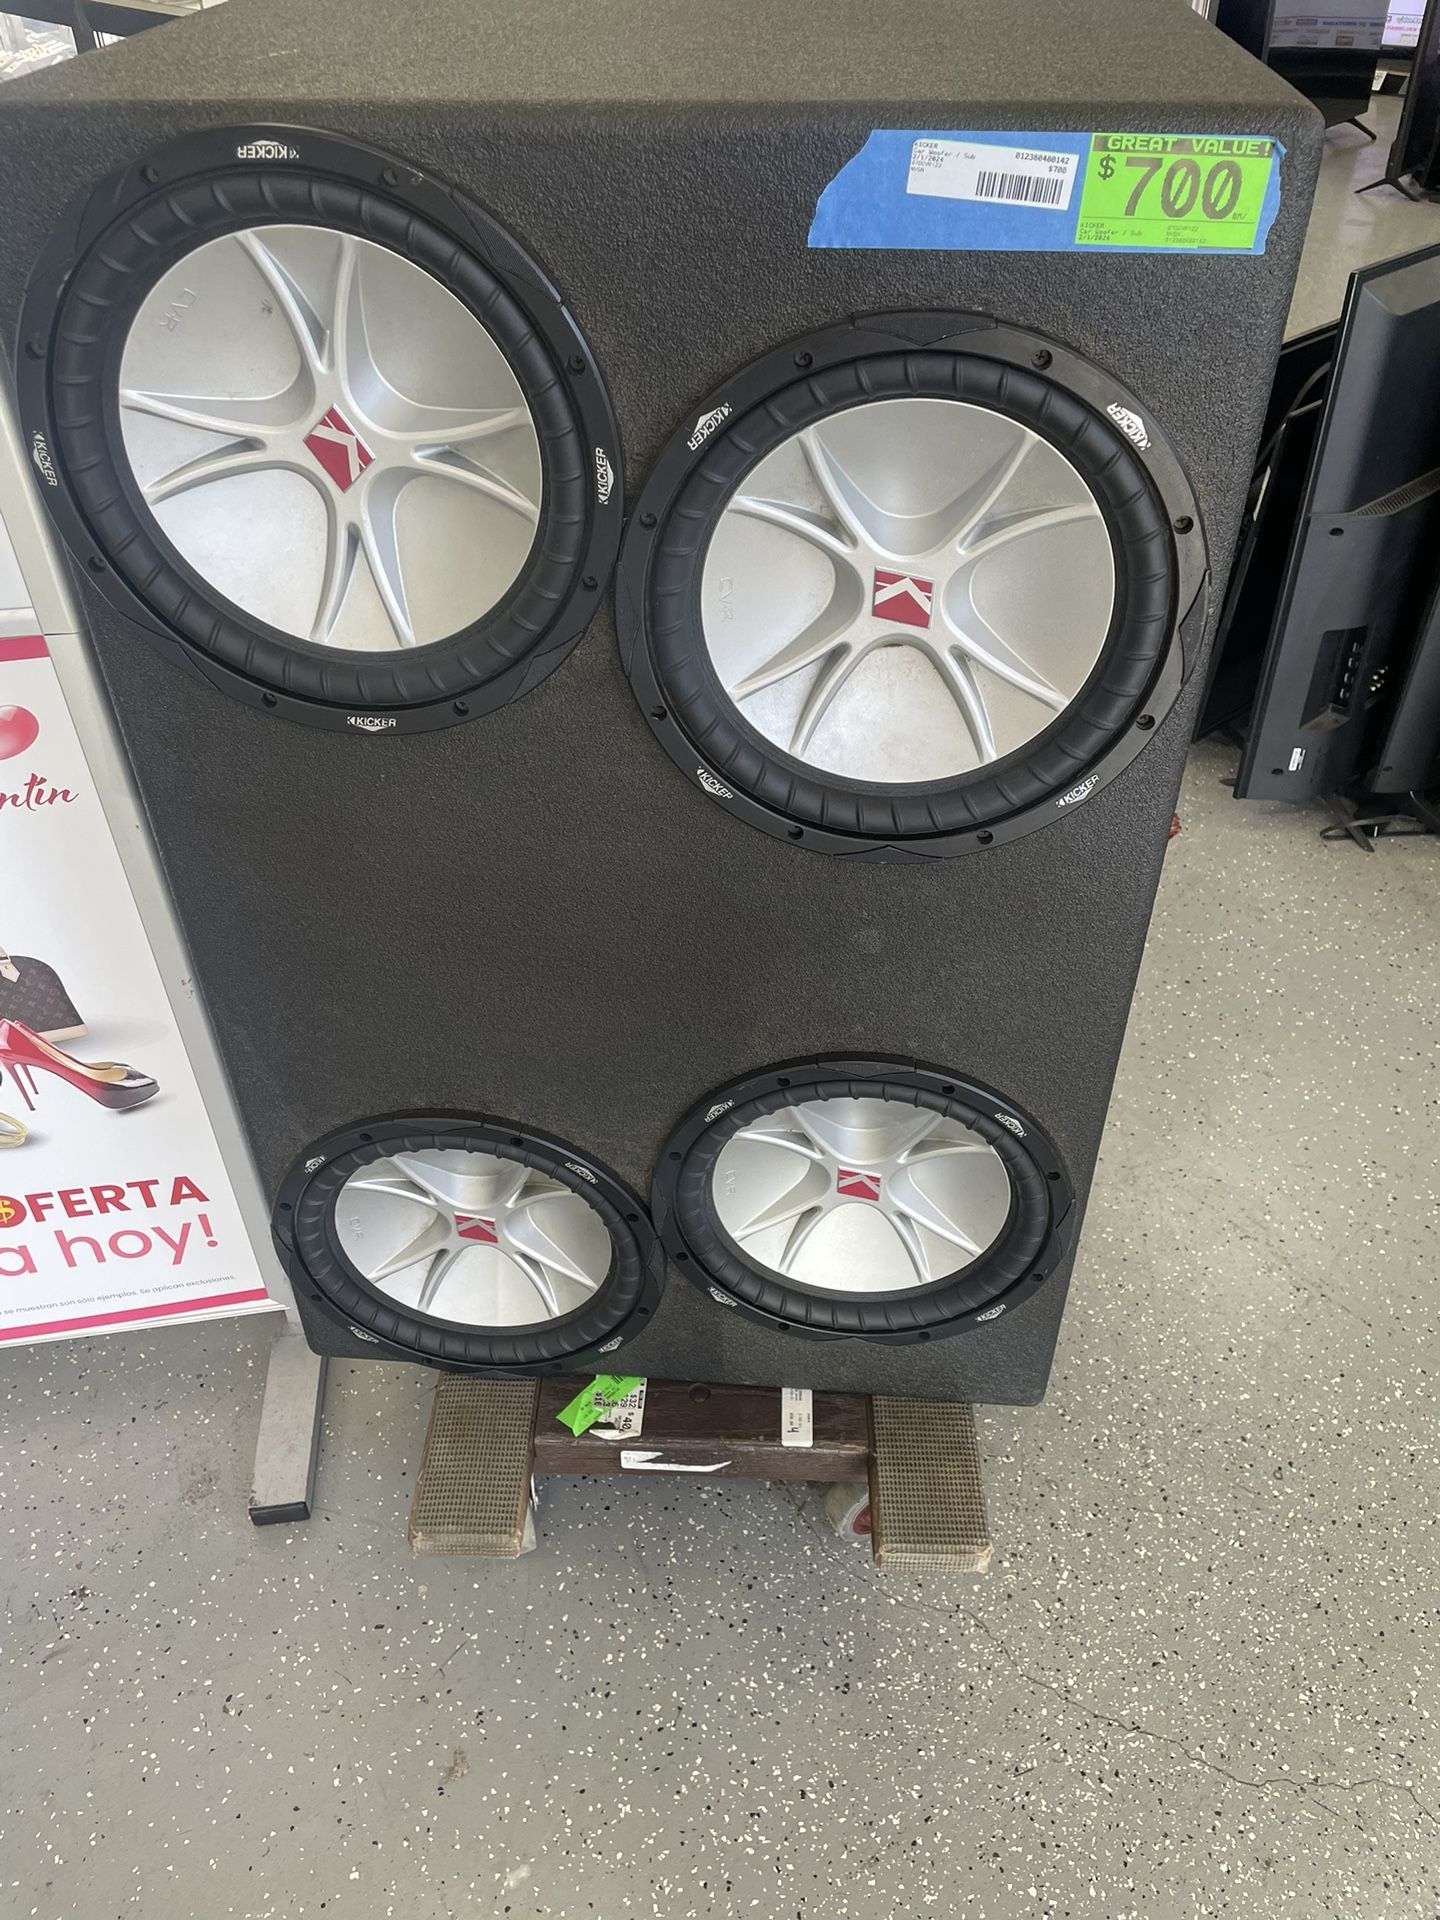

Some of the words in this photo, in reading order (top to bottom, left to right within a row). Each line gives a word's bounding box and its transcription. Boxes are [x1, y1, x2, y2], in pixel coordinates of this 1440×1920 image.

[237, 144, 290, 159] KICKER
[914, 141, 939, 149] KICKER
[929, 149, 952, 157] Woofer
[1107, 135, 1178, 151] GREAT
[1192, 138, 1272, 156] VALUE!
[912, 154, 944, 162] 2/1/2024
[1098, 154, 1243, 220] $700
[687, 406, 728, 451] KICKER
[1106, 402, 1147, 448] KICKER
[38, 440, 58, 487] KICKER
[595, 447, 610, 497] KICKER
[357, 716, 397, 729] KICKER
[701, 769, 734, 800] KICKER
[1063, 775, 1100, 804] KICKER
[704, 1100, 732, 1122] KICKER
[995, 1113, 1025, 1138] KICKER
[565, 1162, 595, 1184] KICKER
[54, 1213, 219, 1268] hoy!
[16, 1302, 58, 1313] muestran
[152, 1282, 185, 1293] aplican
[711, 1288, 738, 1308] KICKER
[978, 1303, 1007, 1321] KICKER
